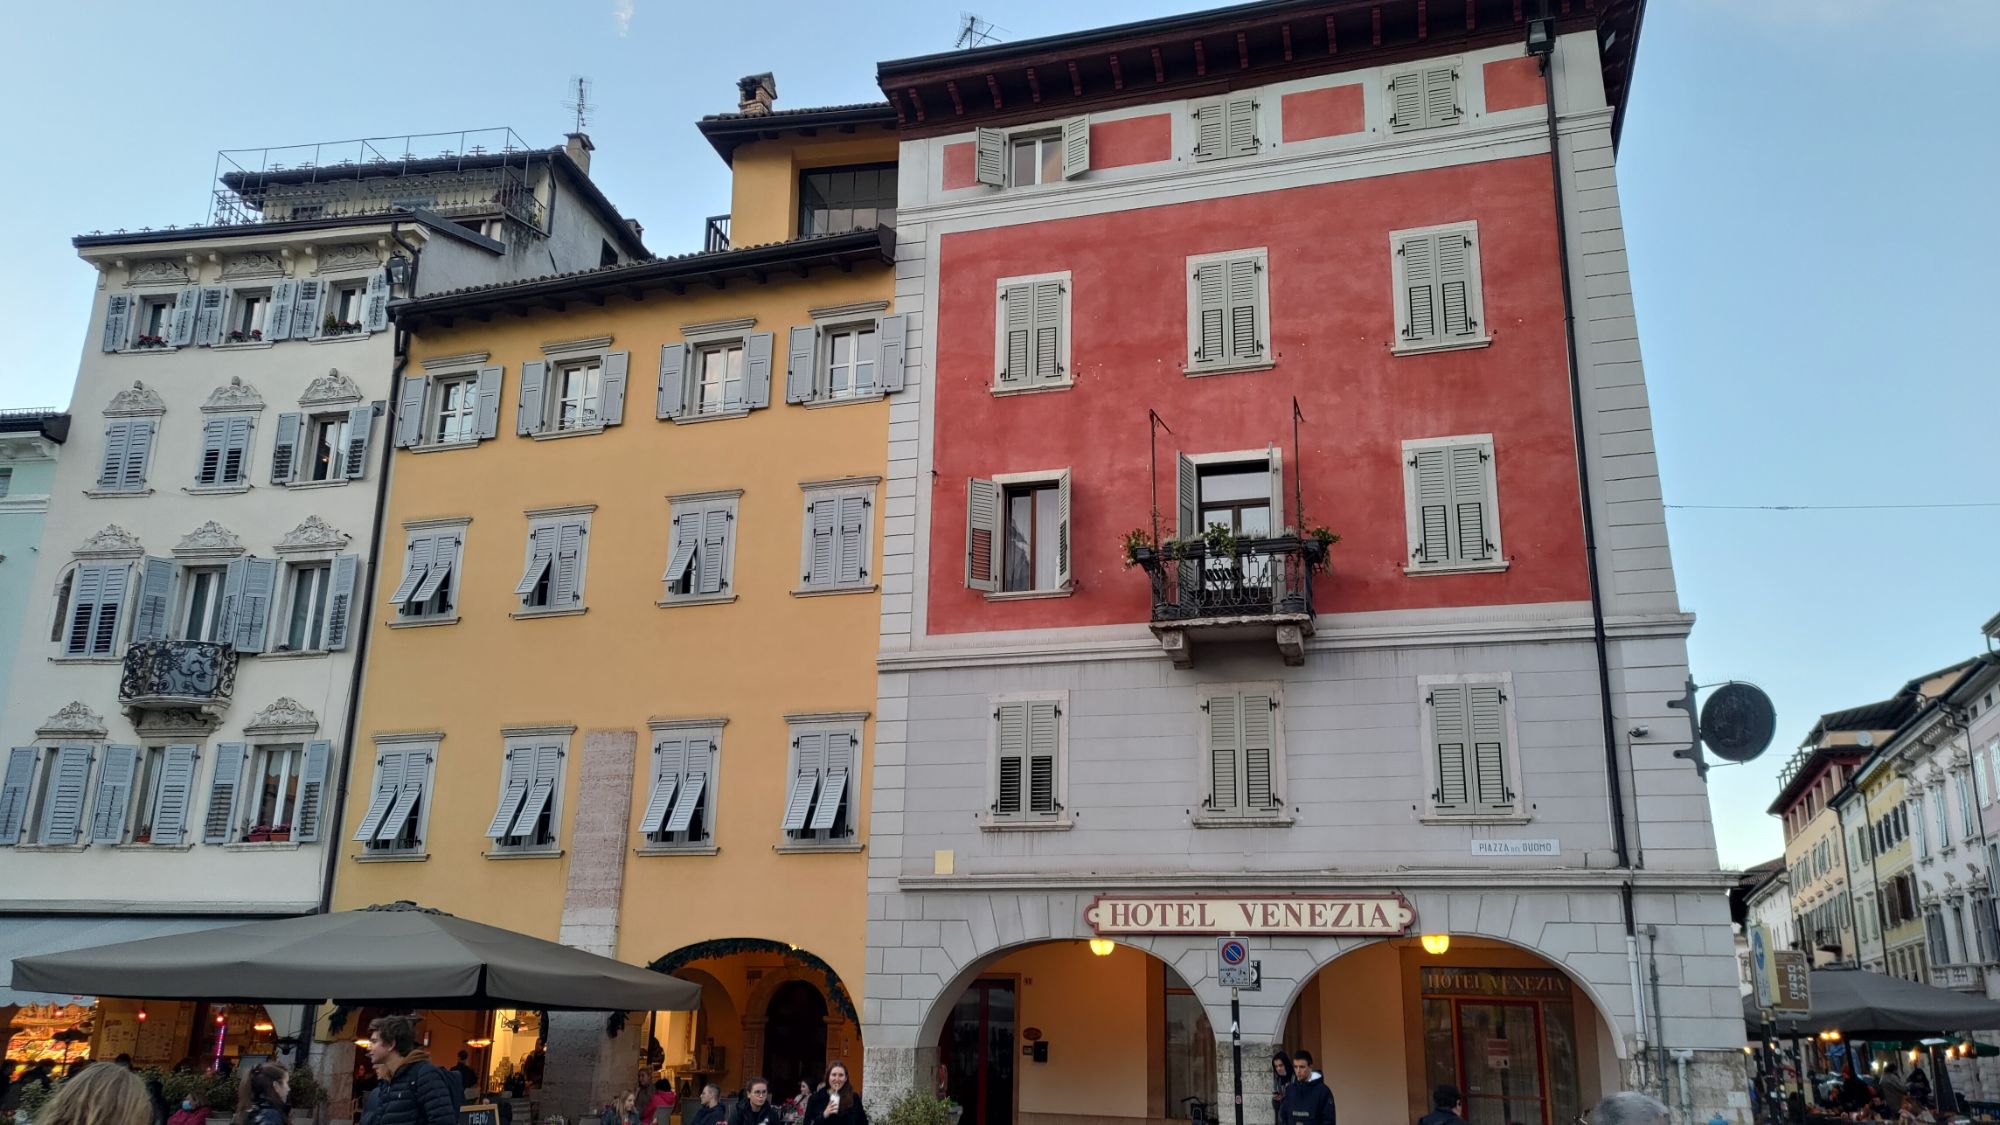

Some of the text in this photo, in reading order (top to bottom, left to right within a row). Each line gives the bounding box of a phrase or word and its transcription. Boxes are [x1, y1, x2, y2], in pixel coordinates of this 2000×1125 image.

[1479, 842, 1510, 852] PIAZZA
[1522, 842, 1552, 852] DUOMO
[1109, 903, 1393, 928] HOTEL VENEZIA
[1428, 973, 1565, 991] HOTEL VENEZIA
